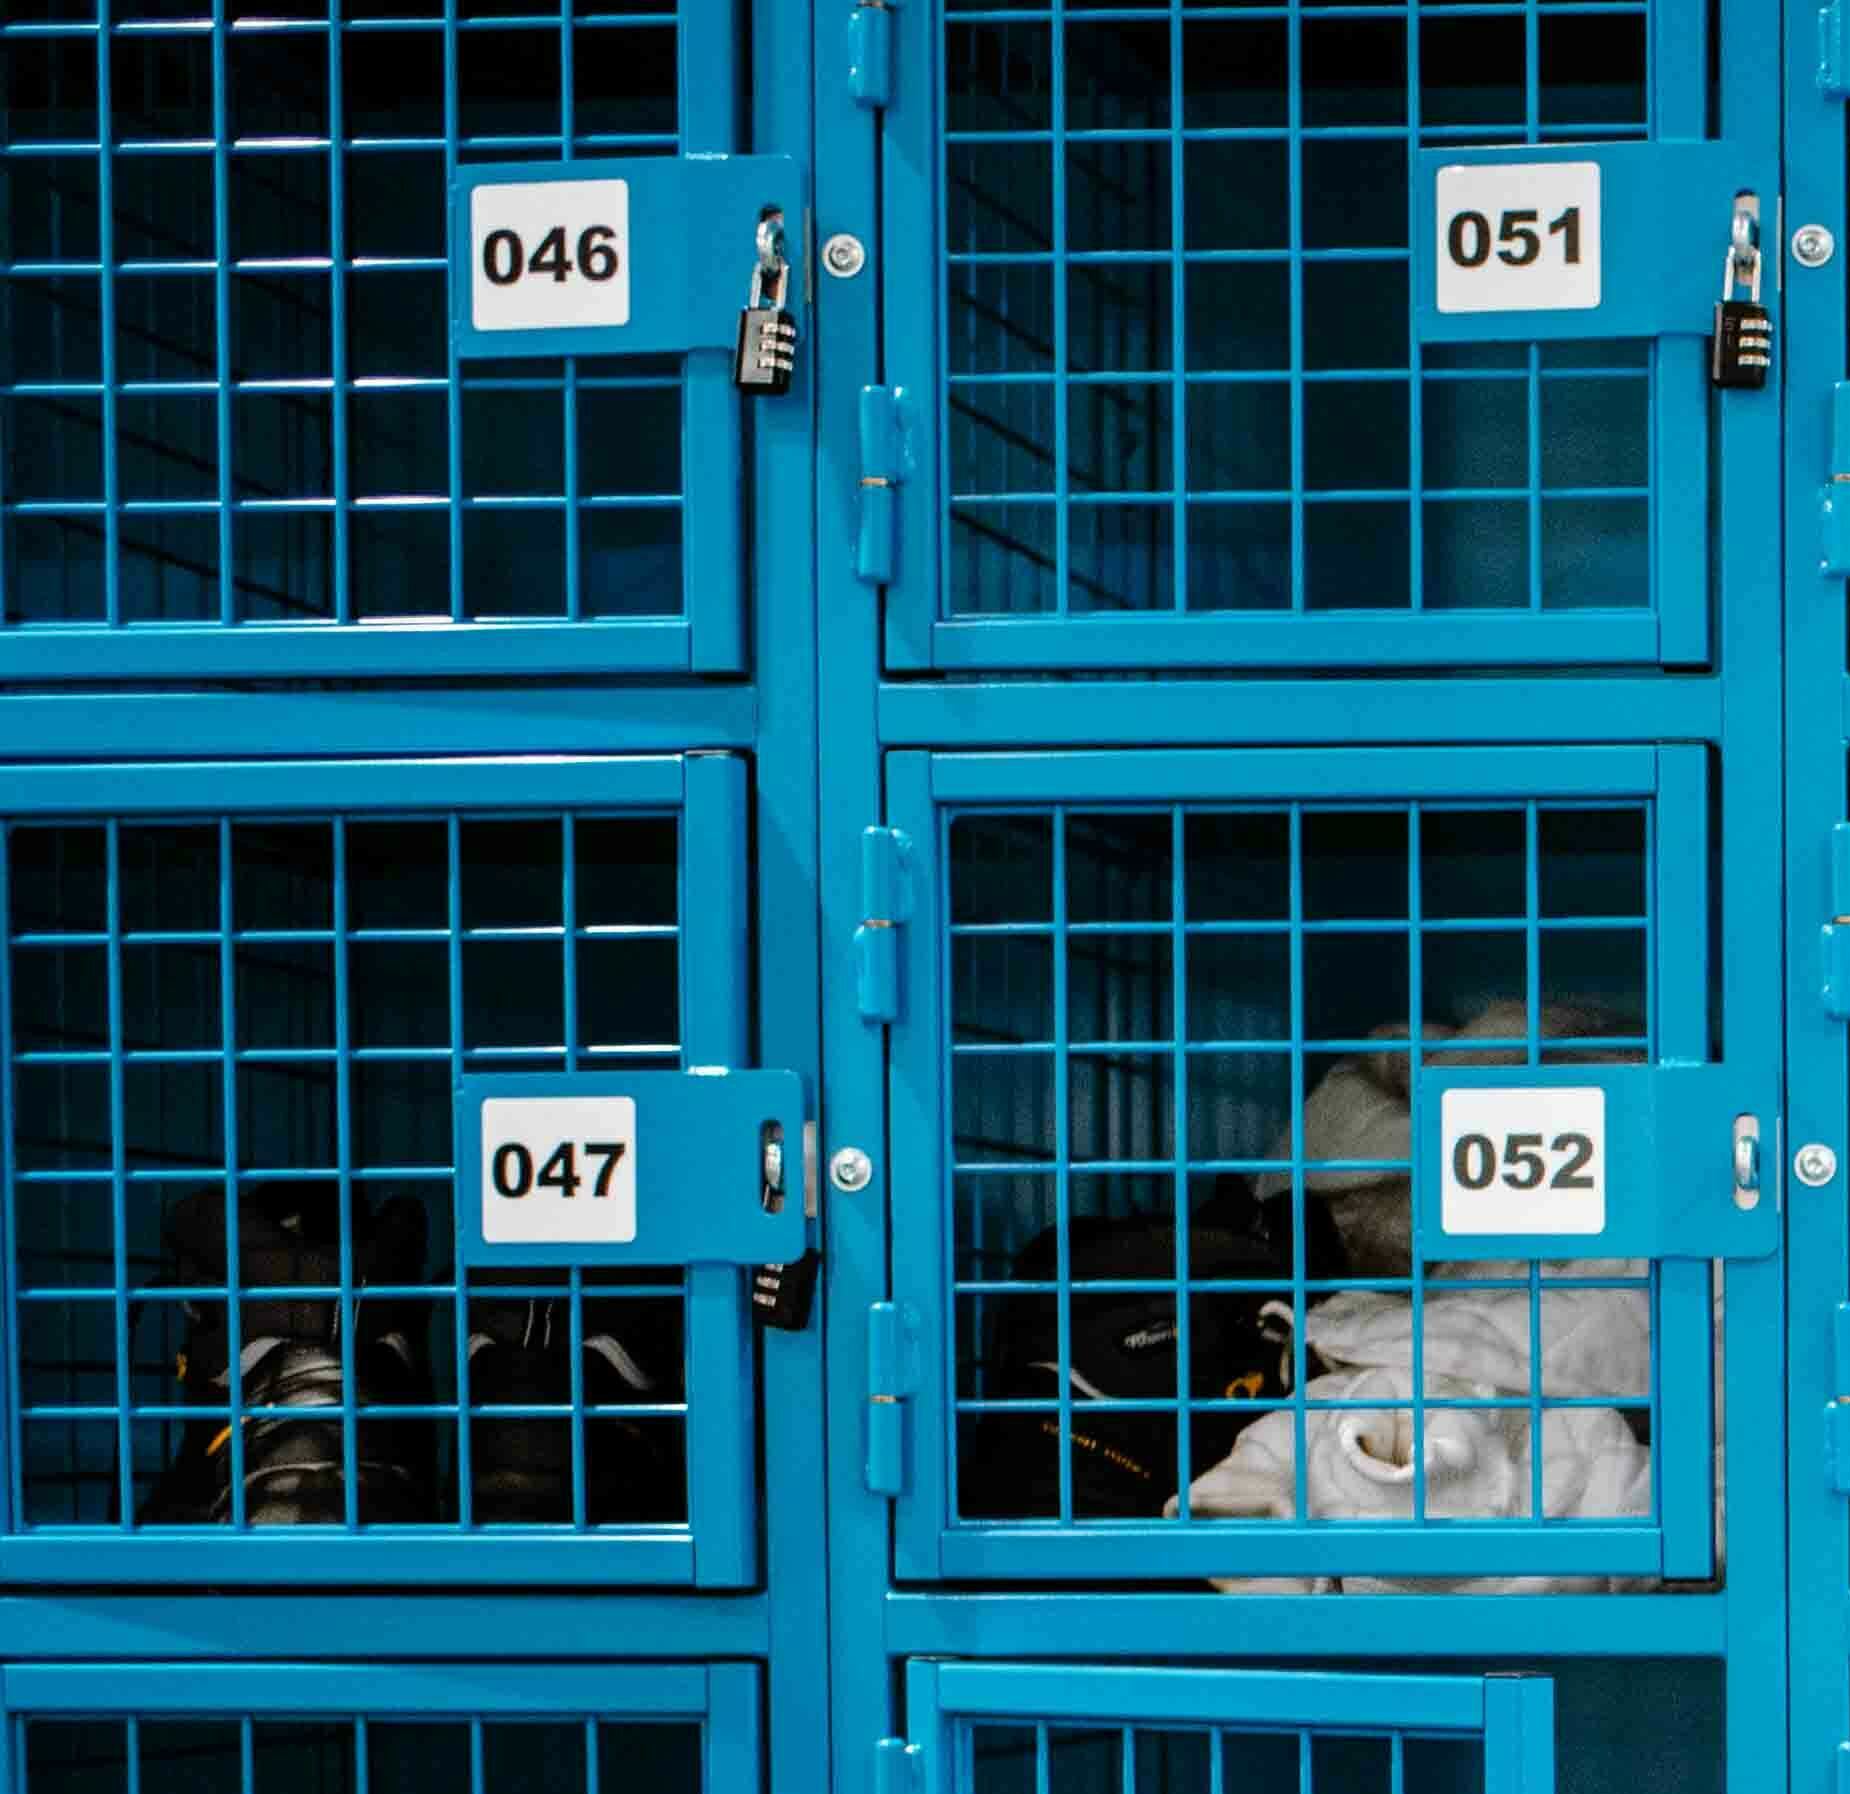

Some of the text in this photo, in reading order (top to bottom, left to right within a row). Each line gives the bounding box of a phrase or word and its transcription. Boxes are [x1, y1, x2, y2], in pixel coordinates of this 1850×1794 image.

[482, 224, 619, 286] 046
[1447, 206, 1580, 269] 051
[491, 1141, 626, 1200] 047
[1452, 1133, 1594, 1190] 052
